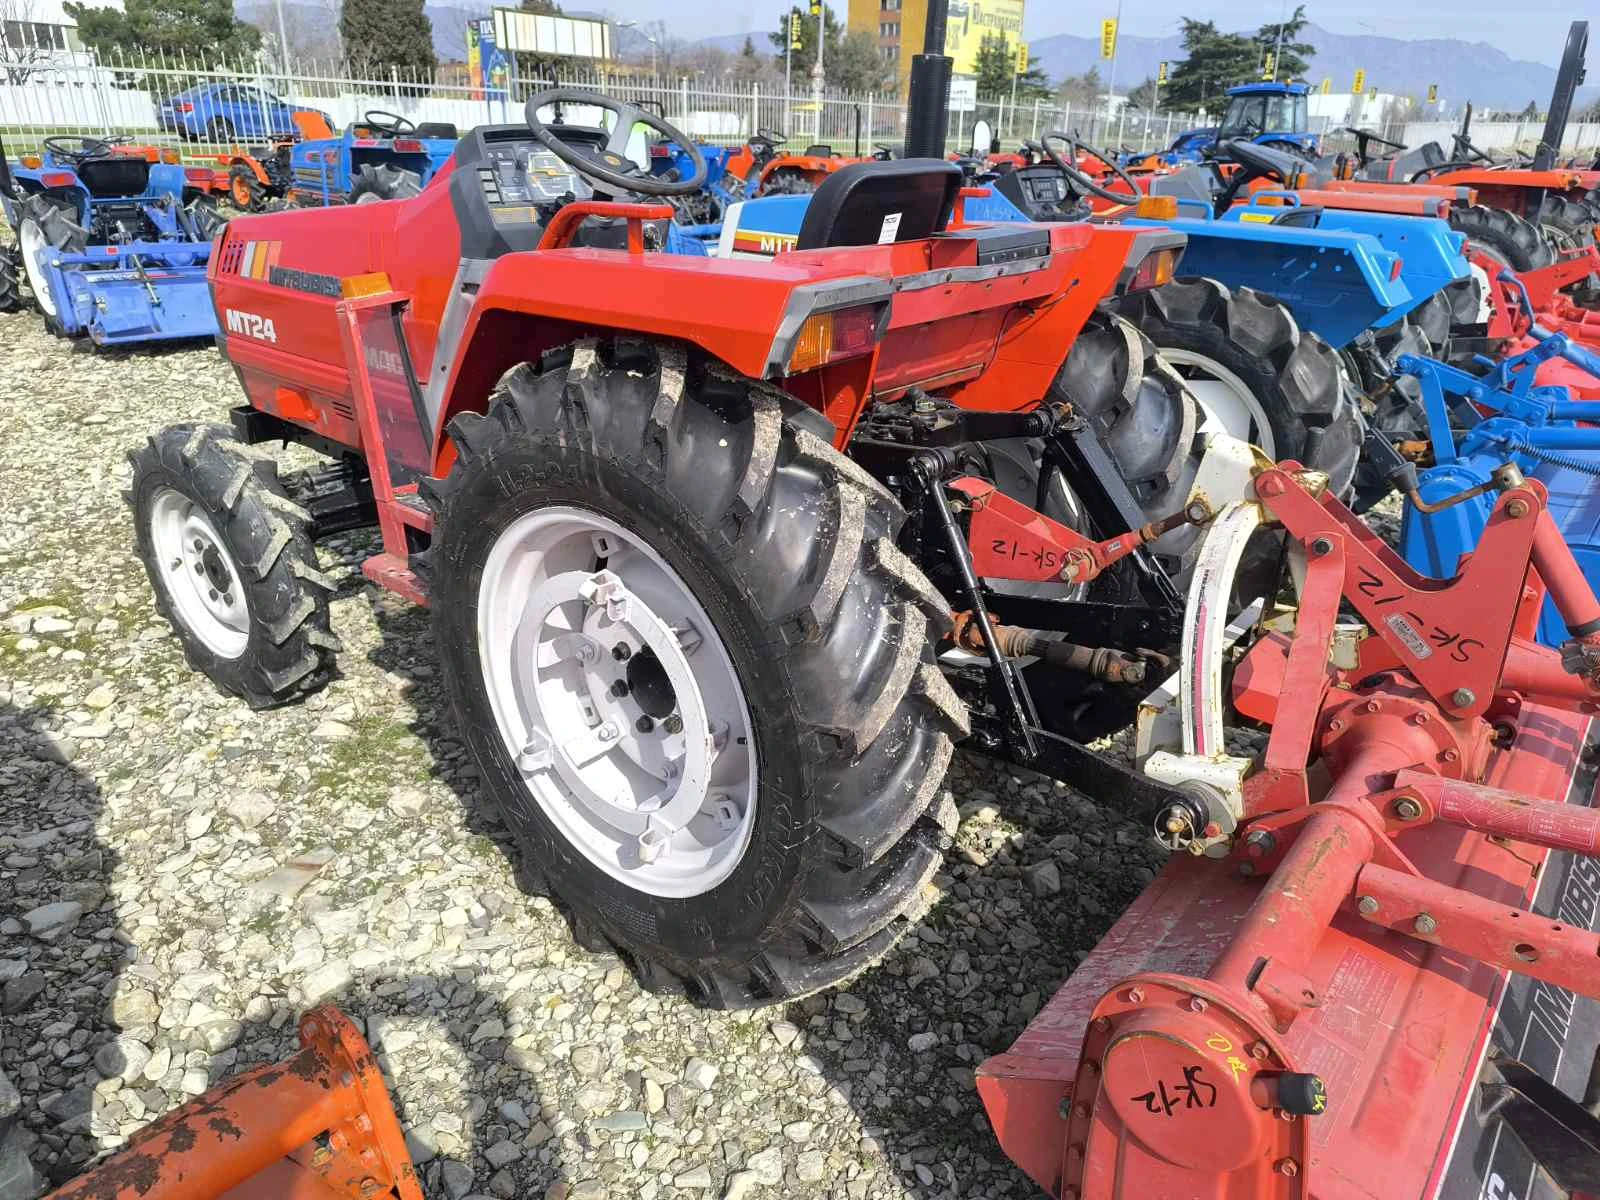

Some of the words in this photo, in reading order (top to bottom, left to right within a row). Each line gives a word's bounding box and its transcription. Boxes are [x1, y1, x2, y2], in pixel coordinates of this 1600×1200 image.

[760, 237, 798, 253] MIT
[226, 308, 277, 343] MT24
[992, 540, 1057, 569] SK-12
[1358, 566, 1485, 662] SK-12
[1130, 1065, 1217, 1117] SK-12
